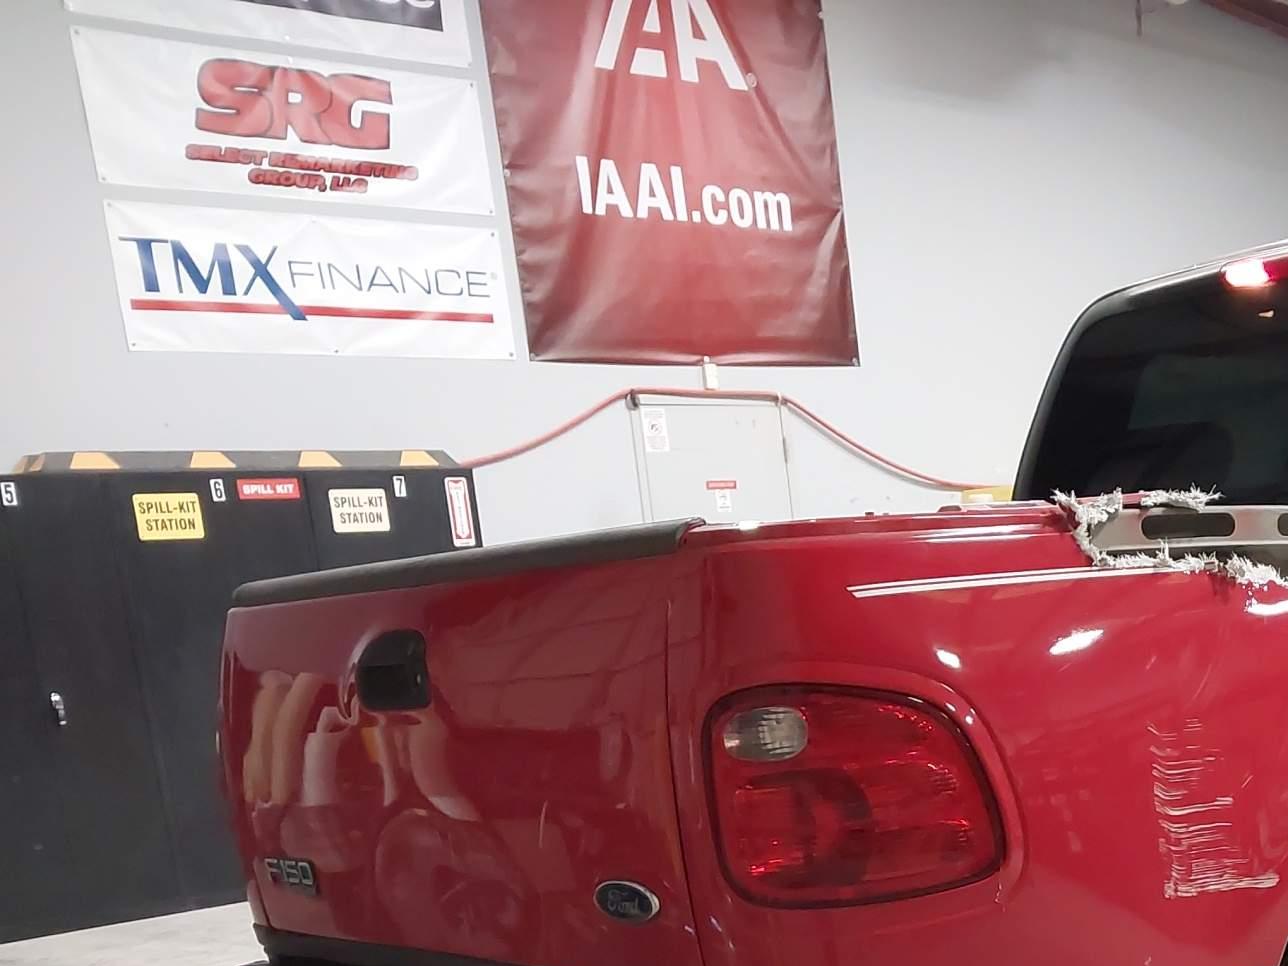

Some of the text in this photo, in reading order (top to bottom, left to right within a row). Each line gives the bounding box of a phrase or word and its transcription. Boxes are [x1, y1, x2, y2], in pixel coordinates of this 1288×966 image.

[195, 58, 393, 150] SRG
[185, 143, 267, 165] SELECT
[575, 155, 793, 232] IAAI.com
[118, 235, 491, 321] TMX FINANCE
[4, 483, 15, 504] 5
[213, 480, 223, 499] 6
[242, 483, 295, 496] SPILL KIT
[395, 477, 403, 496] 7
[138, 501, 197, 514] SPILL-KIT
[333, 495, 384, 508] SPILL-KIT
[145, 517, 197, 532] STATION
[339, 511, 383, 524] STATION
